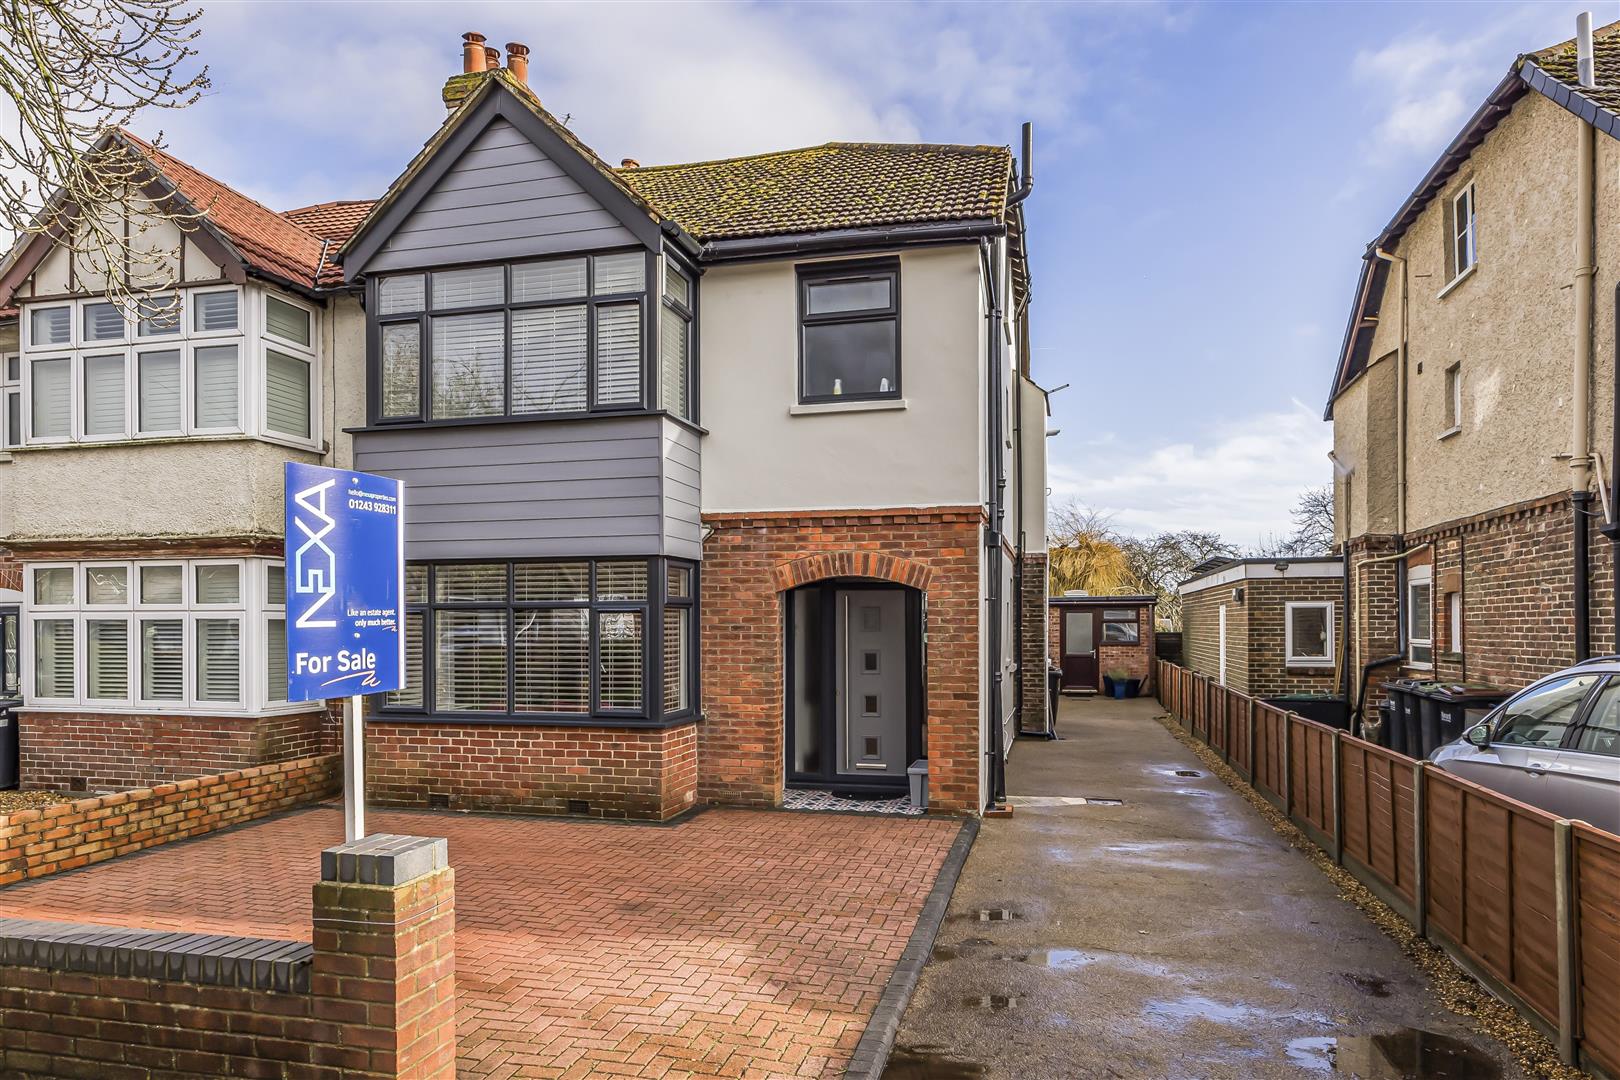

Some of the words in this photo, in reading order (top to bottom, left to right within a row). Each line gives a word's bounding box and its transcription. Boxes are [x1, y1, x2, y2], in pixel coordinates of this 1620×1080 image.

[349, 498, 372, 511] 01243
[374, 502, 396, 515] 928311
[295, 479, 336, 628] NEXA
[347, 608, 358, 616] Like
[355, 619, 366, 627] only
[296, 653, 332, 674] For
[337, 648, 376, 671] Sale
